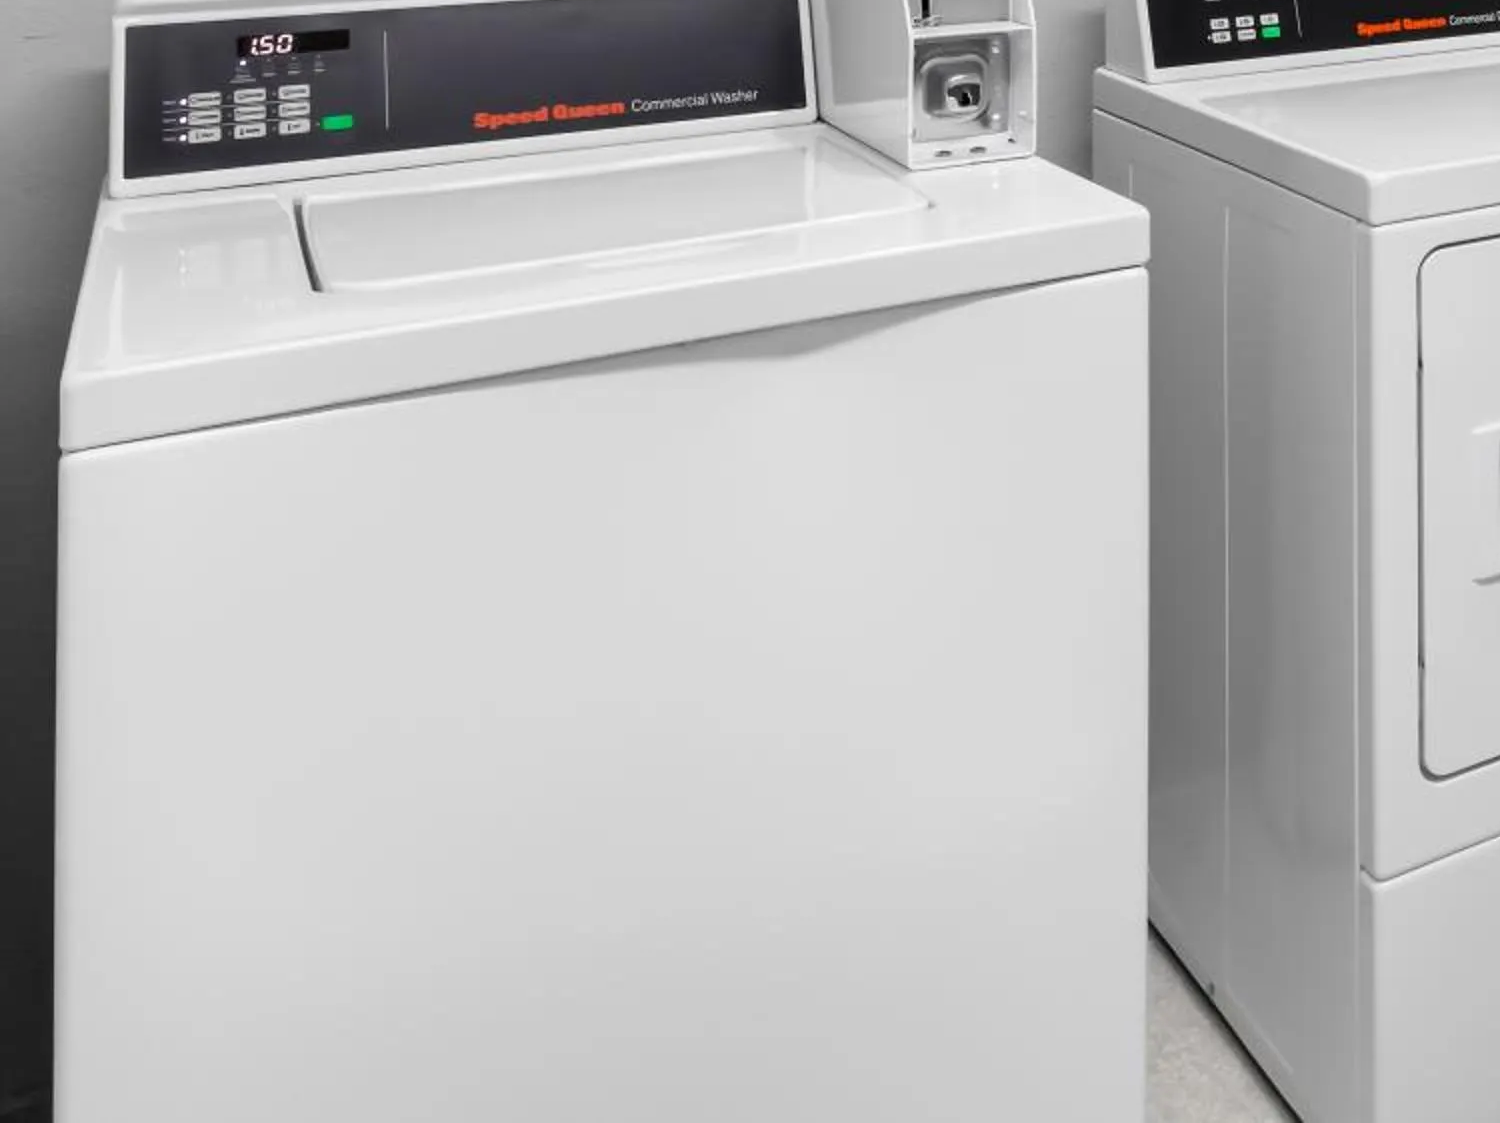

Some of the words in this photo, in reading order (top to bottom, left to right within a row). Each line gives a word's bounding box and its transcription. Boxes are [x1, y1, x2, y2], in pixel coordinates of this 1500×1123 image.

[1357, 21, 1400, 36] Speed
[1403, 17, 1446, 30] Queen
[1449, 13, 1495, 26] Commercial
[474, 107, 548, 129] Speed
[553, 102, 624, 120] Queen
[631, 94, 708, 113] Commercial
[712, 90, 759, 105] Washer
